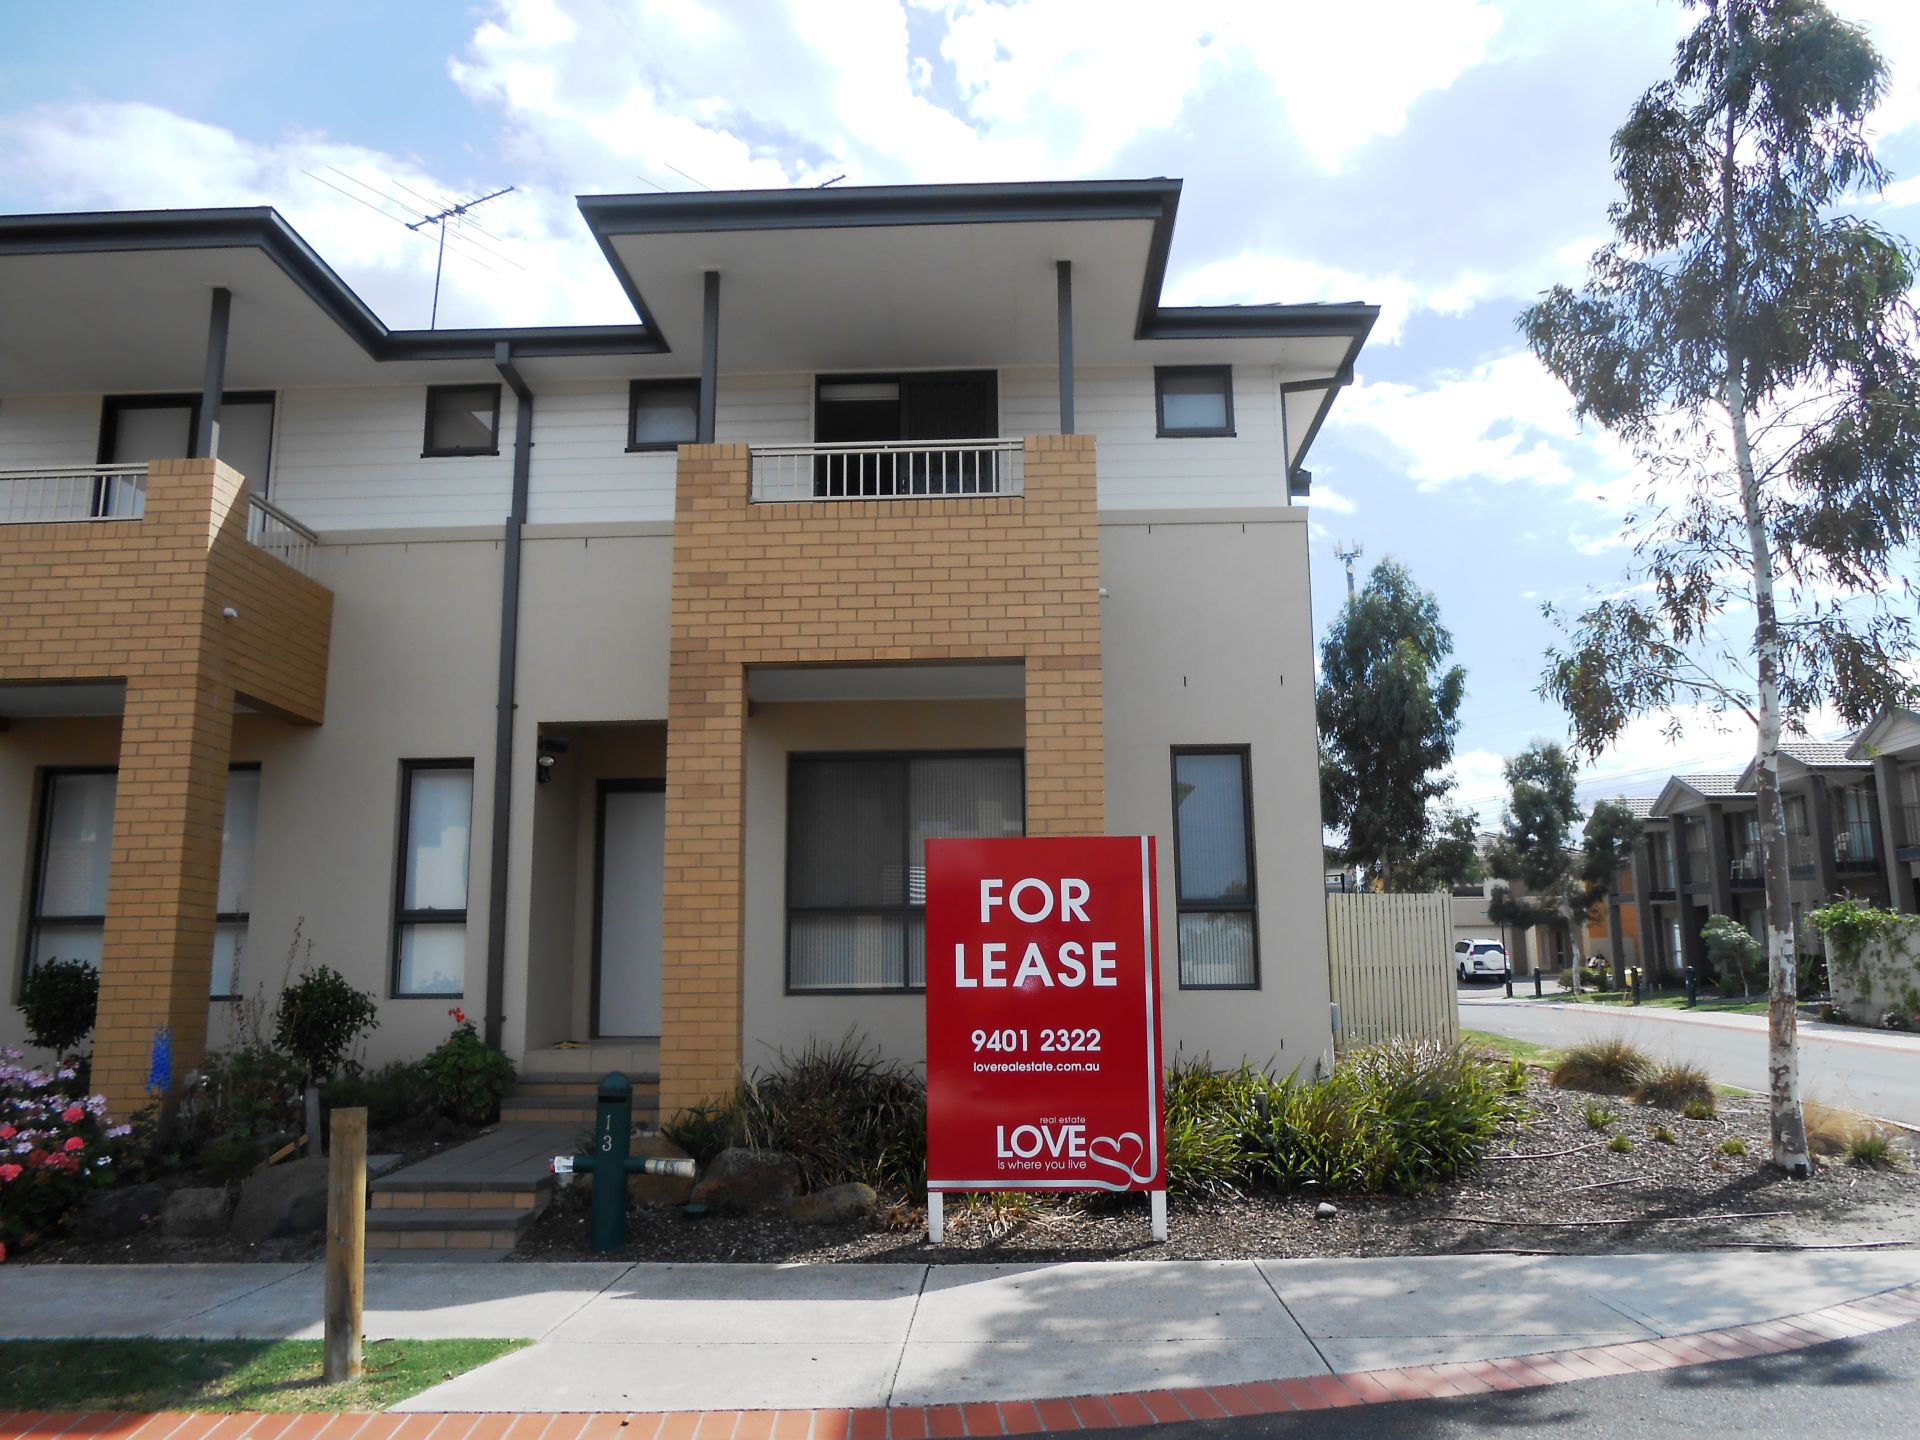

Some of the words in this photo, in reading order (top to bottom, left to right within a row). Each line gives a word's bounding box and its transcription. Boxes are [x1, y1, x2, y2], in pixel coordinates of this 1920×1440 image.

[980, 877, 1091, 923] FOR
[955, 941, 1117, 988] LEASE
[971, 1029, 1028, 1052] 9401
[1040, 1028, 1101, 1052] 2322
[973, 1061, 1100, 1072] loverealestate.com.au
[1040, 1116, 1057, 1124] real
[1058, 1116, 1086, 1124] estate
[996, 1124, 1086, 1158] LOVE
[997, 1159, 1005, 1169] is
[1007, 1160, 1042, 1169] where
[1044, 1161, 1065, 1172] you
[1068, 1159, 1087, 1169] live
